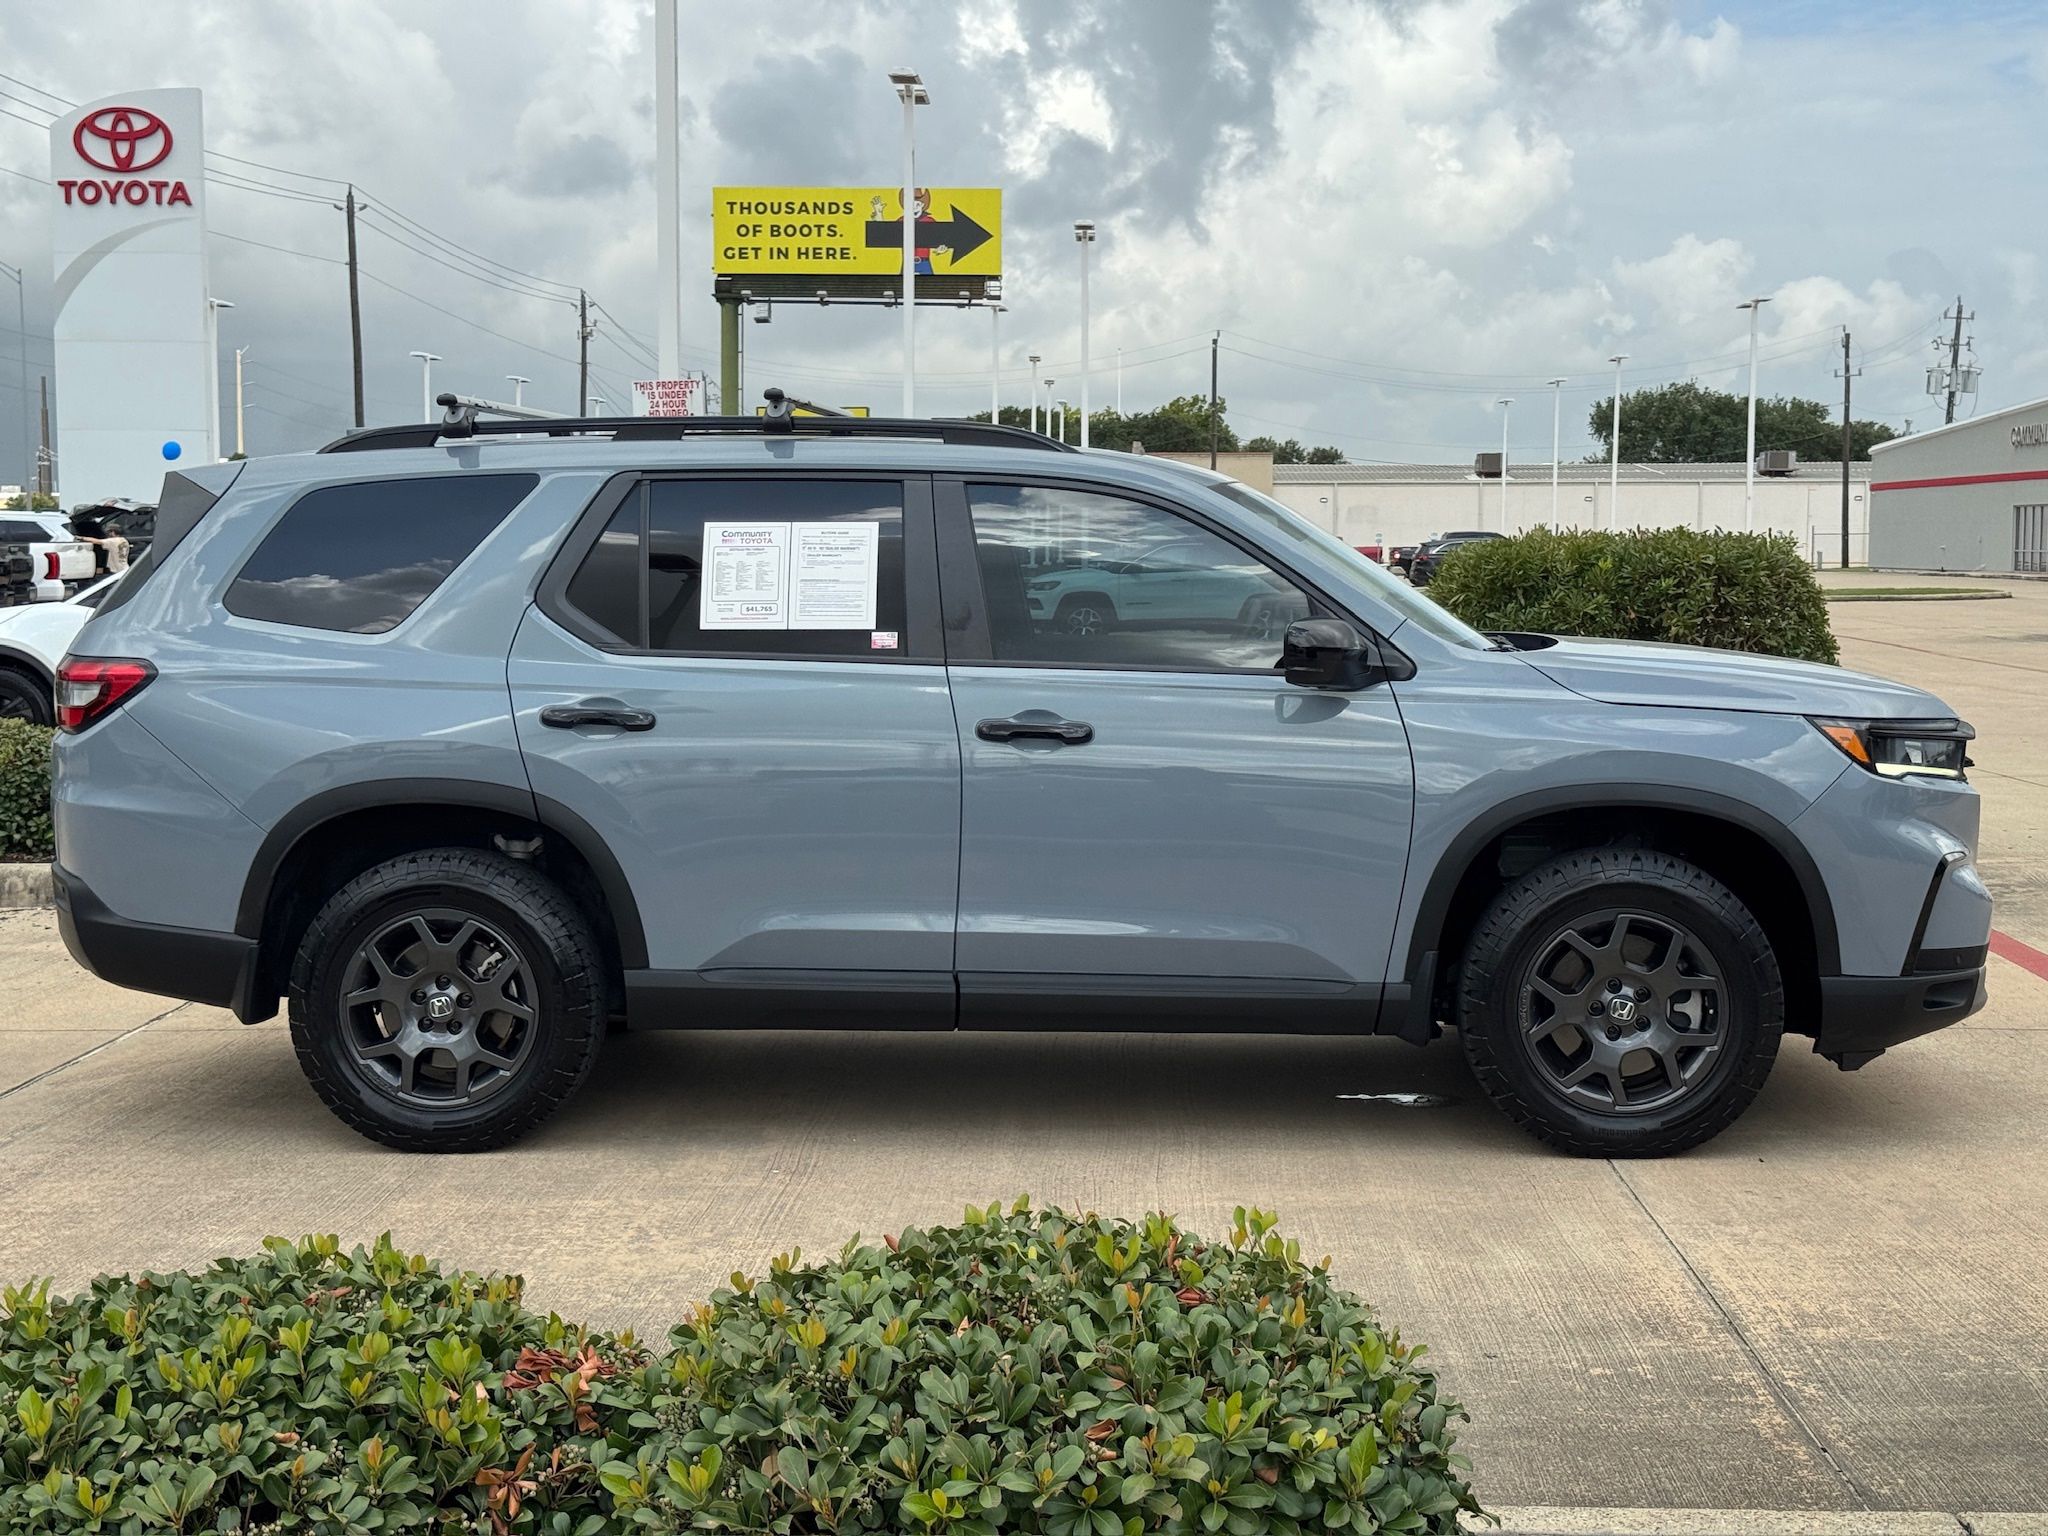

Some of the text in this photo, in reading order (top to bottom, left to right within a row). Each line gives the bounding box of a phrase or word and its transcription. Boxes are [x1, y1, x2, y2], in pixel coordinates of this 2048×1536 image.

[58, 180, 192, 205] TOYOTA
[726, 201, 854, 215] THOUSANDS
[736, 224, 844, 238] OF BOOTS.
[723, 246, 857, 260] GET IN HERE.
[634, 380, 700, 391] THIS PROPERTY
[648, 390, 688, 400] IS UNDER
[650, 400, 687, 409] 24 HOUR
